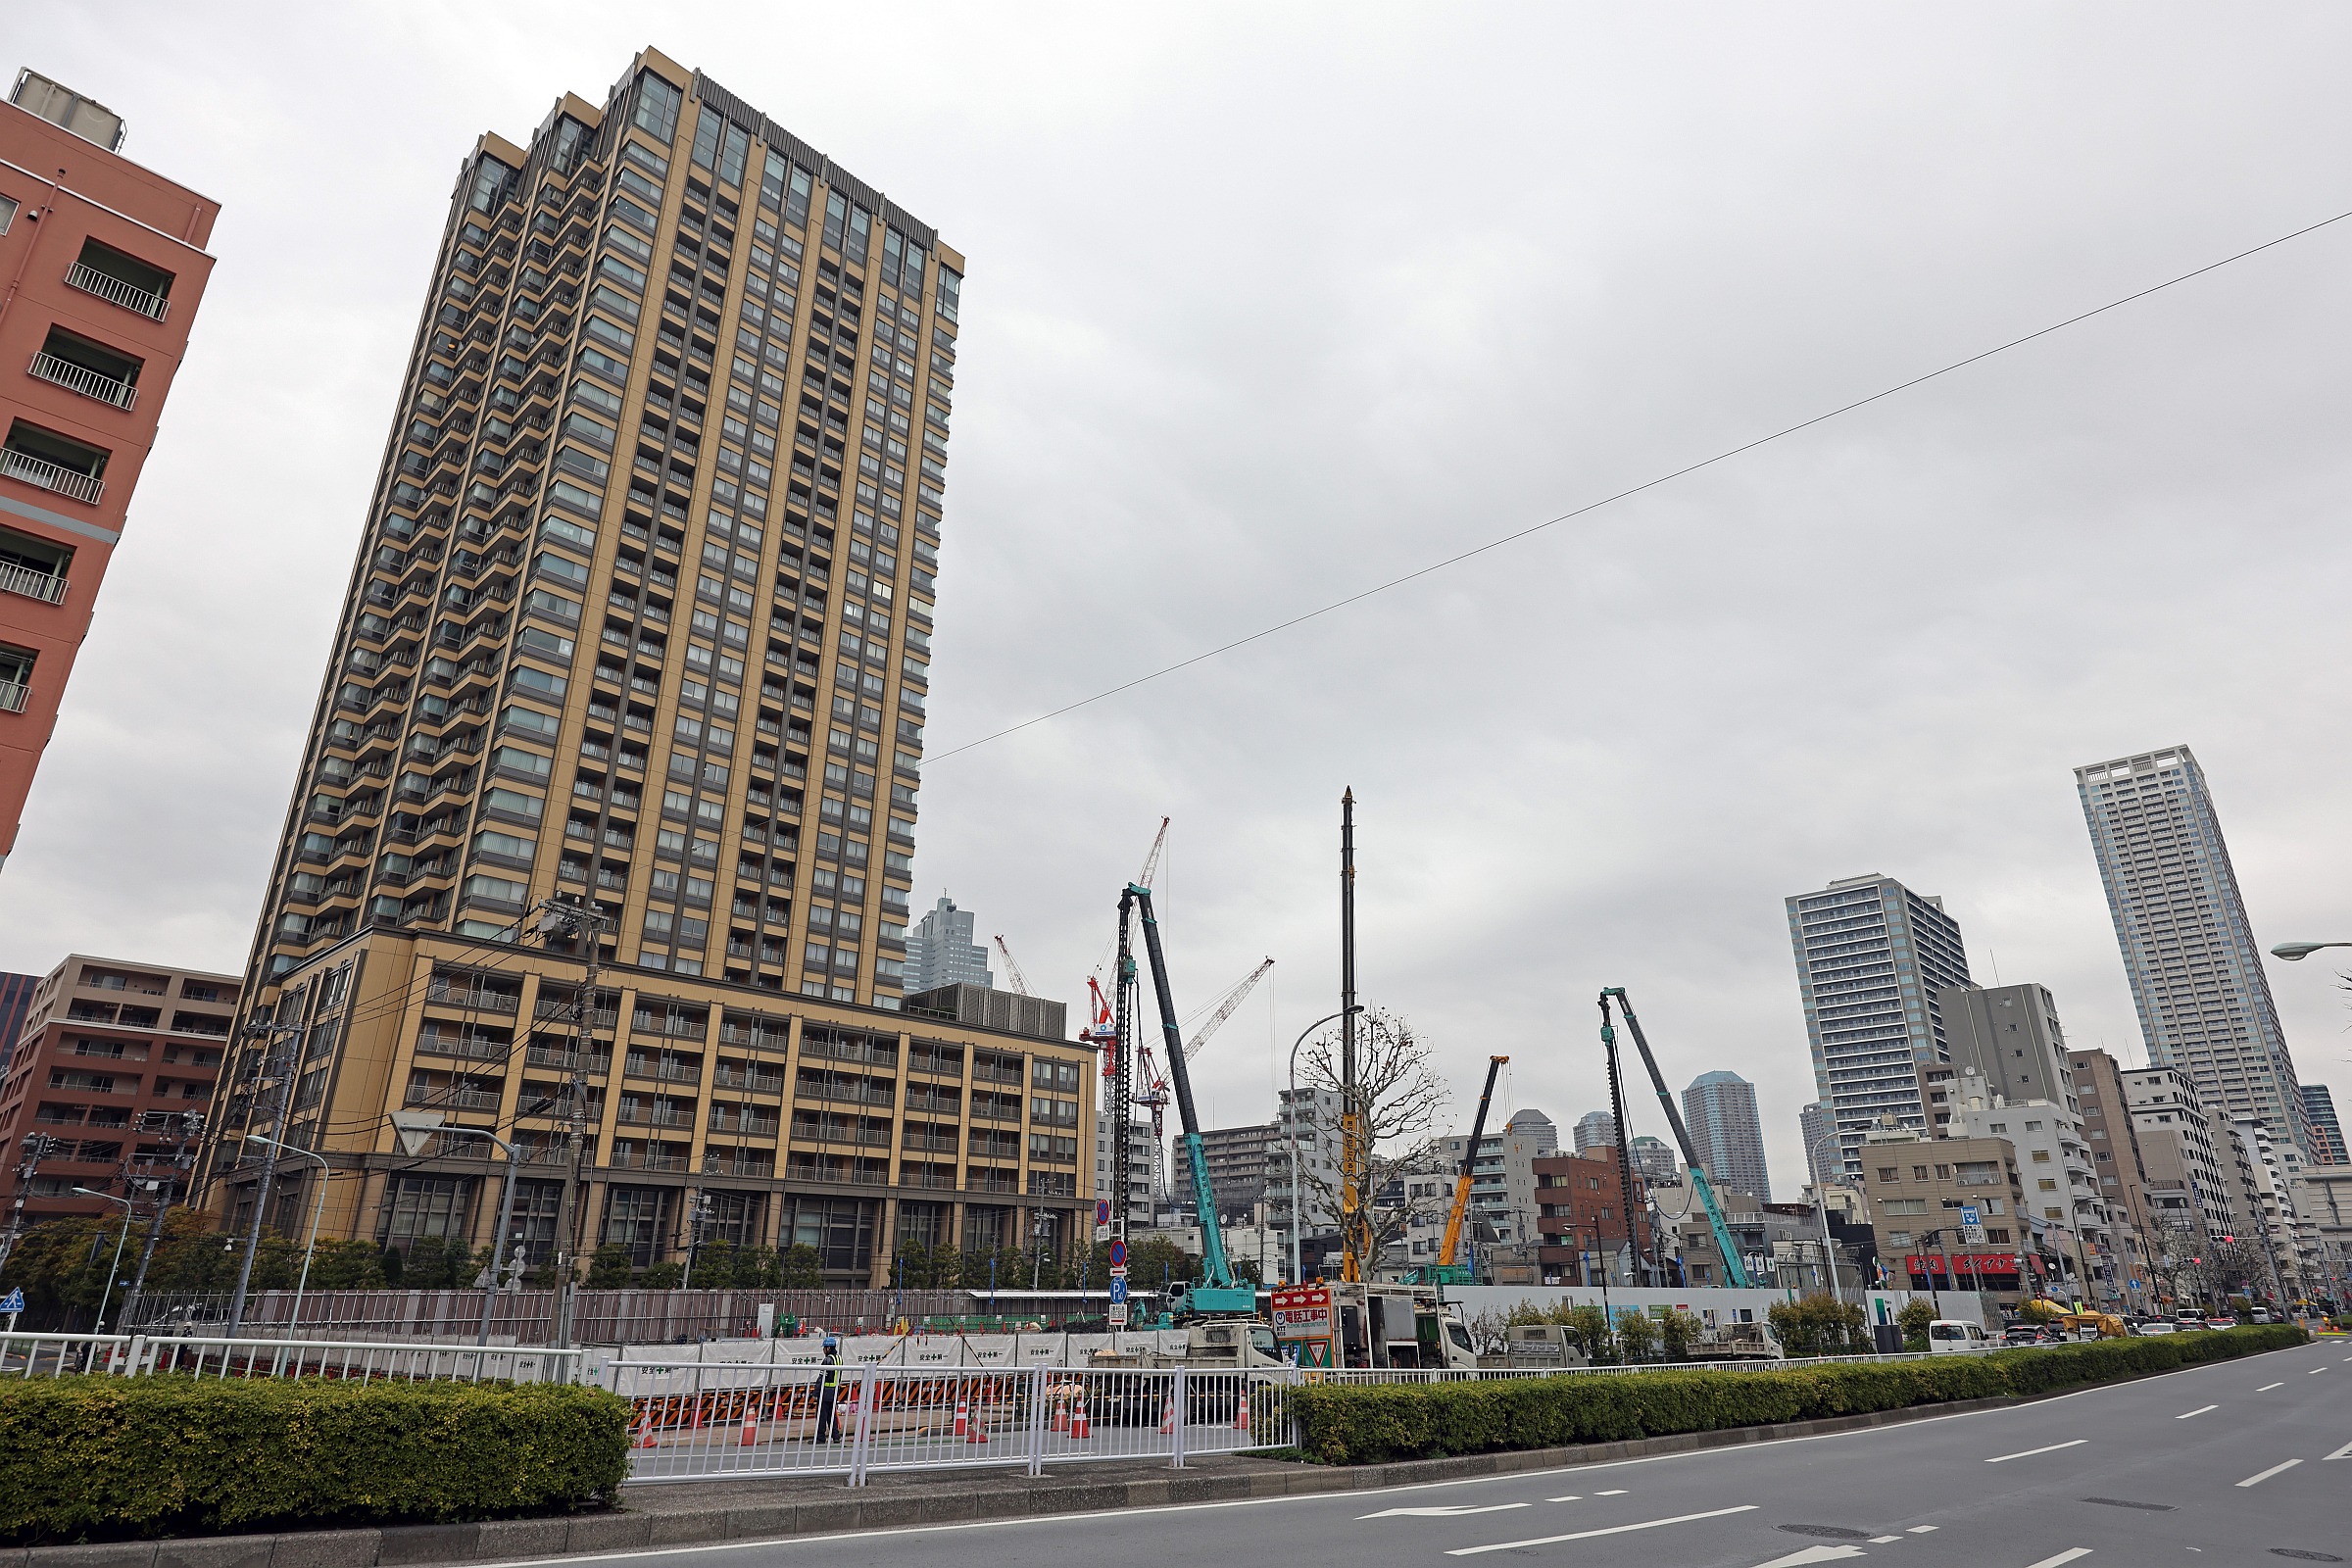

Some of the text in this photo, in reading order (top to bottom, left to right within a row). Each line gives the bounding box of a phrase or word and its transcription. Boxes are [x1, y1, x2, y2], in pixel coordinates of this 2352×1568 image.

[1113, 1283, 1120, 1299] P
[1285, 1308, 1327, 1323] 電話工事中
